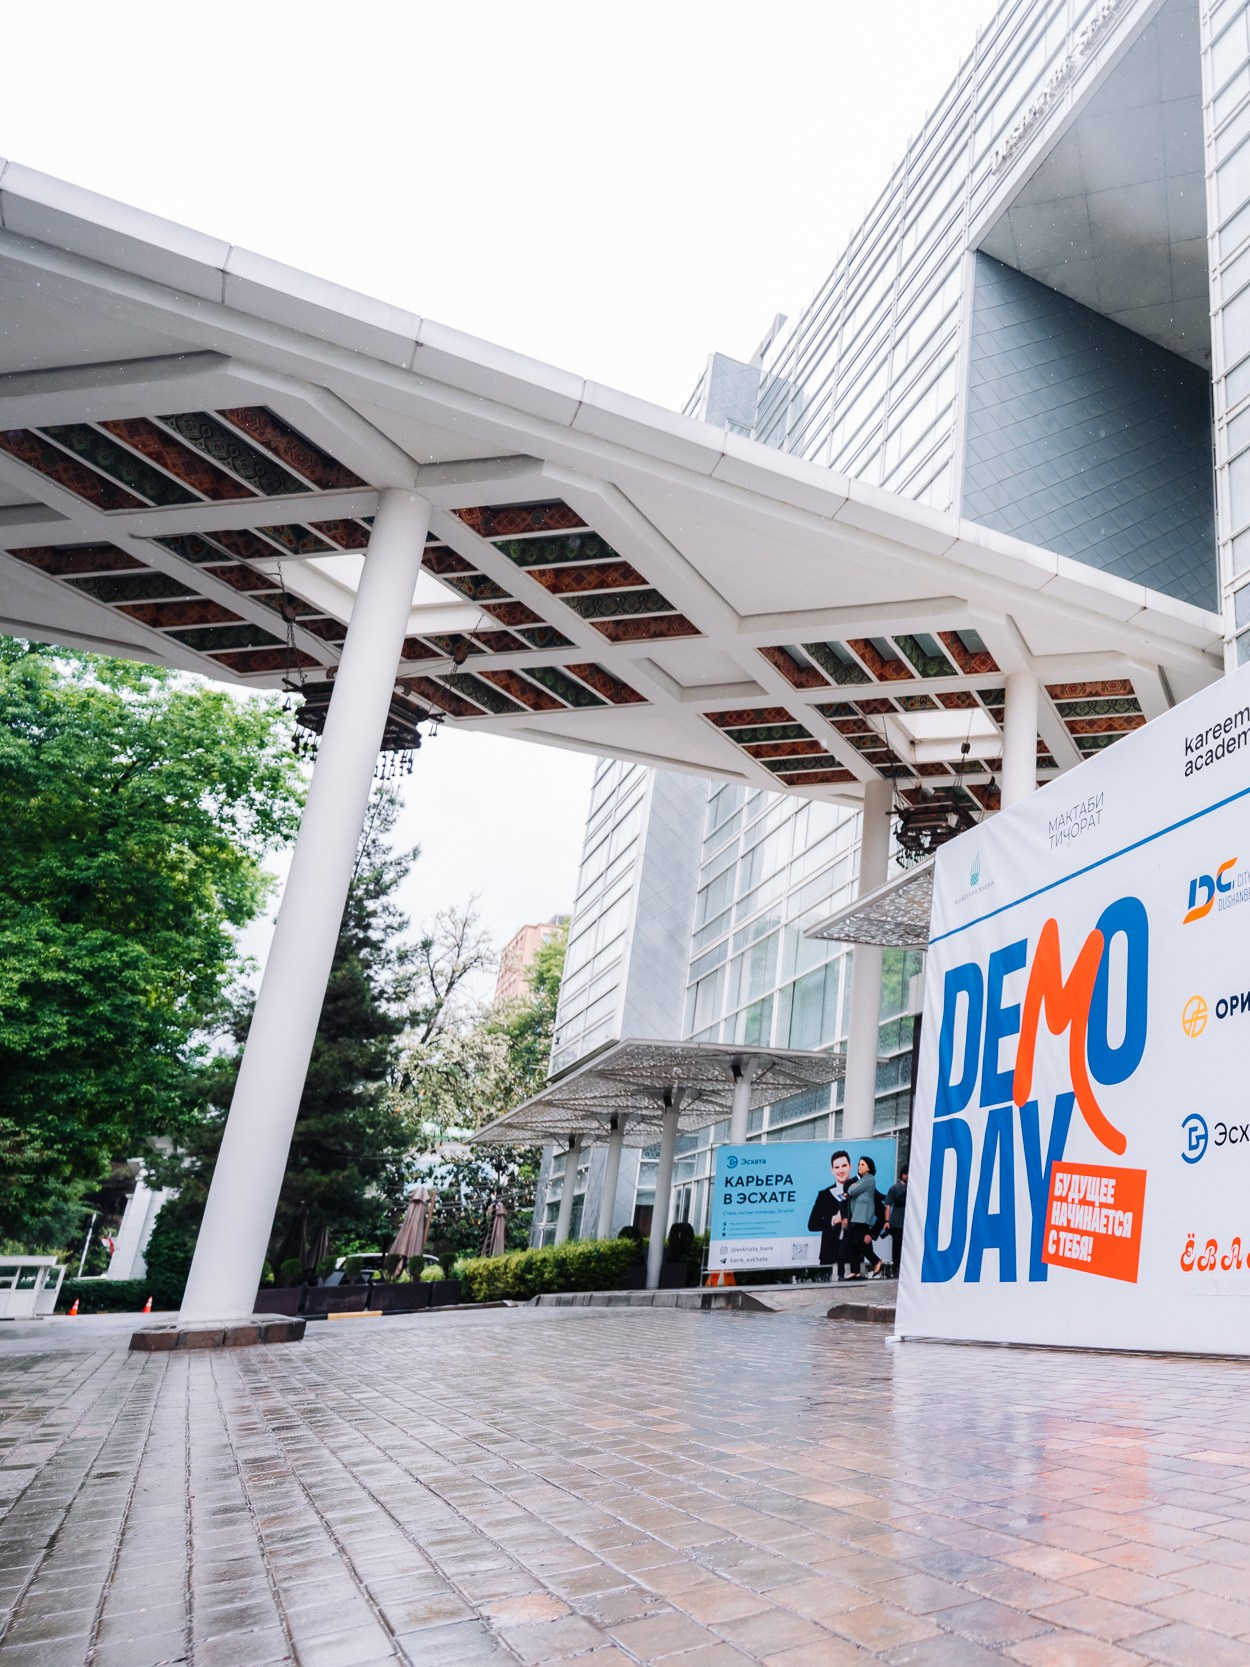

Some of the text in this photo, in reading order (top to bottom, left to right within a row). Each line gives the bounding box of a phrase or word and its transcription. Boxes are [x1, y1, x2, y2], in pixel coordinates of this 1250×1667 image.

[1184, 706, 1250, 756] kareem
[1049, 791, 1104, 834] МАКТАБИ
[934, 896, 1149, 1156] DEMO
[741, 1157, 767, 1165] Эсхата
[723, 1190, 797, 1205] В ЭСХАТЕ
[724, 1173, 794, 1188] КАРЬЕРА
[921, 1092, 1076, 1283] DAY
[1054, 1172, 1117, 1207] БУДУЩЕЕ
[1051, 1201, 1133, 1238] НАЧИНАЕТСЯ
[1048, 1229, 1094, 1262] С ТЕБЯ!
